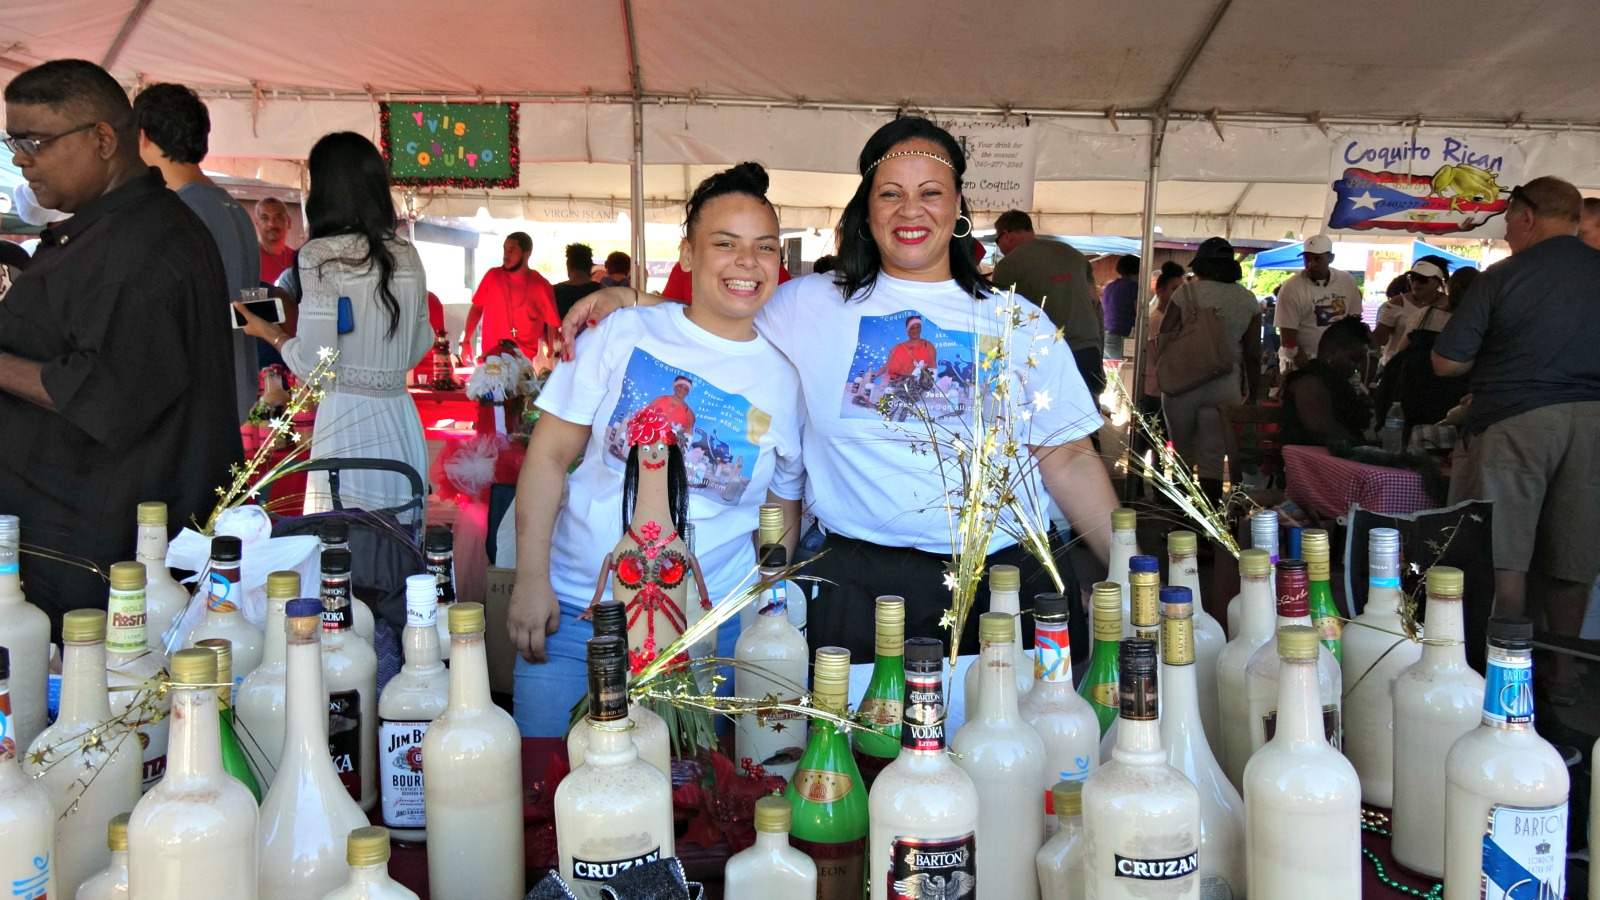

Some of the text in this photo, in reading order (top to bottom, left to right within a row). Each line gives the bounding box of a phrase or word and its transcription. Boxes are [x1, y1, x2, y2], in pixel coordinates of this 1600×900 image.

[412, 112, 466, 137] YVIS
[406, 141, 494, 168] COQUITO
[1343, 136, 1503, 171] Coquito Rican
[980, 179, 1020, 192] Coquito
[544, 209, 579, 219] VIRGIN
[1500, 682, 1534, 716] GIN
[388, 733, 410, 753] JIM
[910, 726, 944, 738] VODKA
[392, 774, 425, 787] BOUR
[1514, 812, 1565, 837] BARTON
[916, 852, 963, 866] BARTON
[1118, 853, 1197, 877] CRUZAN
